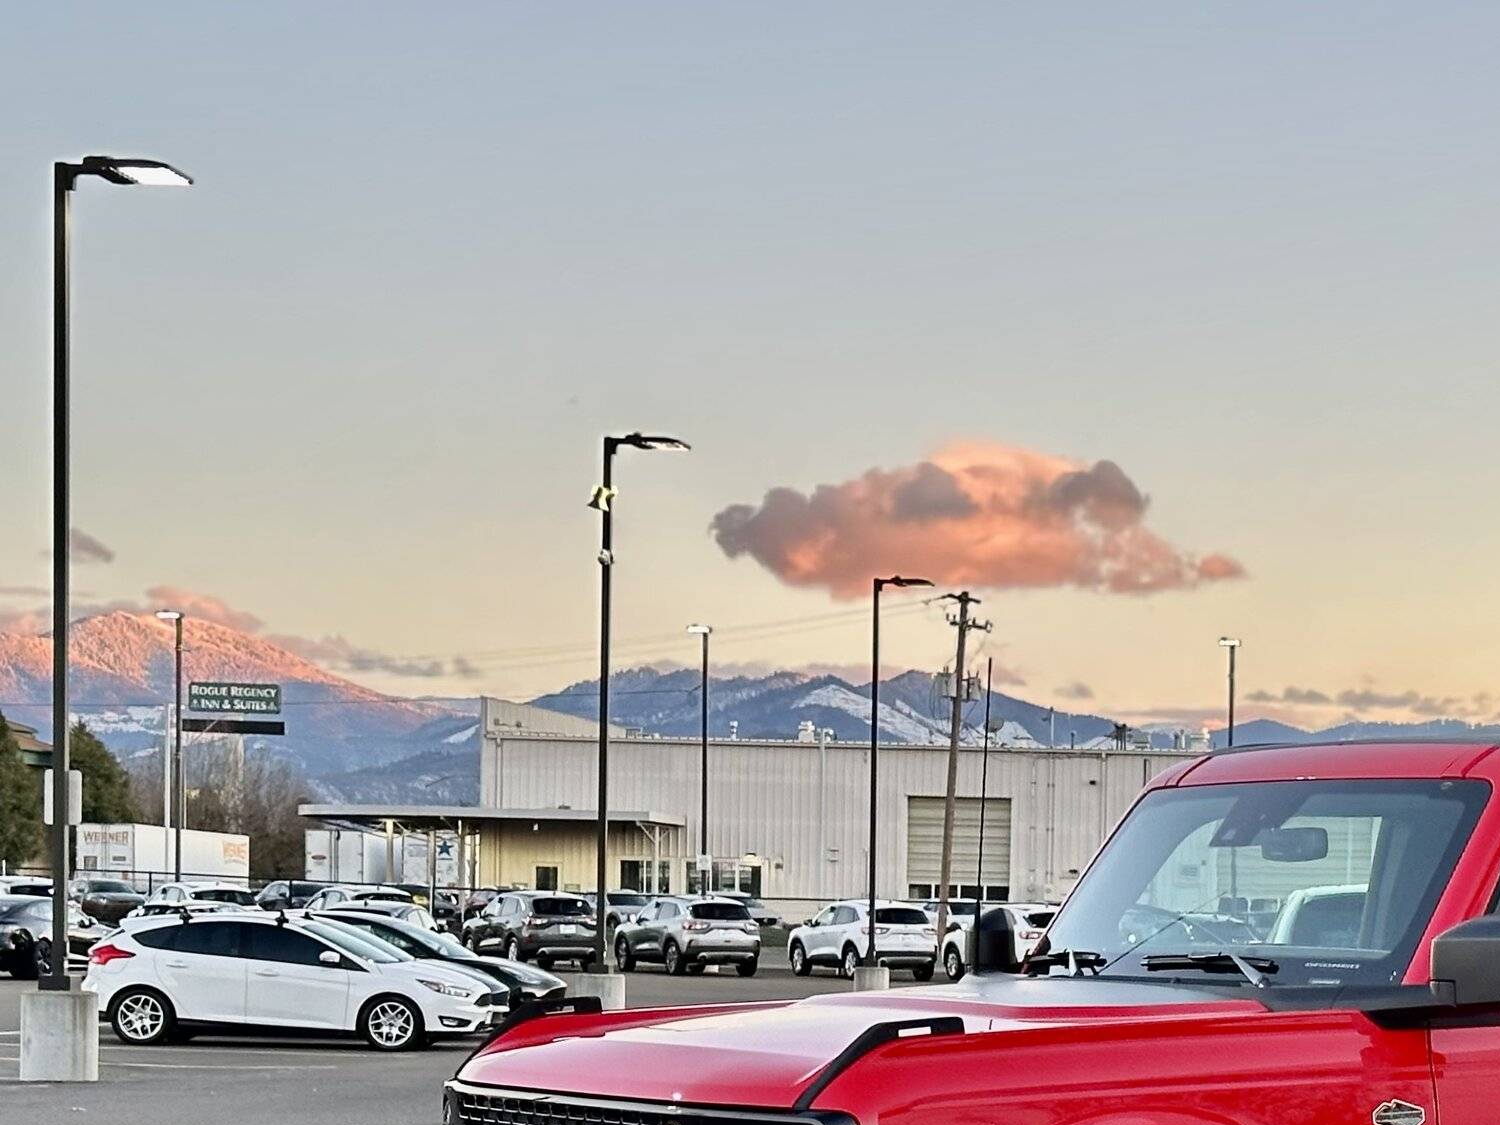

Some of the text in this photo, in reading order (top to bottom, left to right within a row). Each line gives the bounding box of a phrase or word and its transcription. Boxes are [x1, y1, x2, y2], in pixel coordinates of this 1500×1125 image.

[191, 685, 277, 698] ROGUE REGENCY
[201, 699, 267, 711] INN & SUITES
